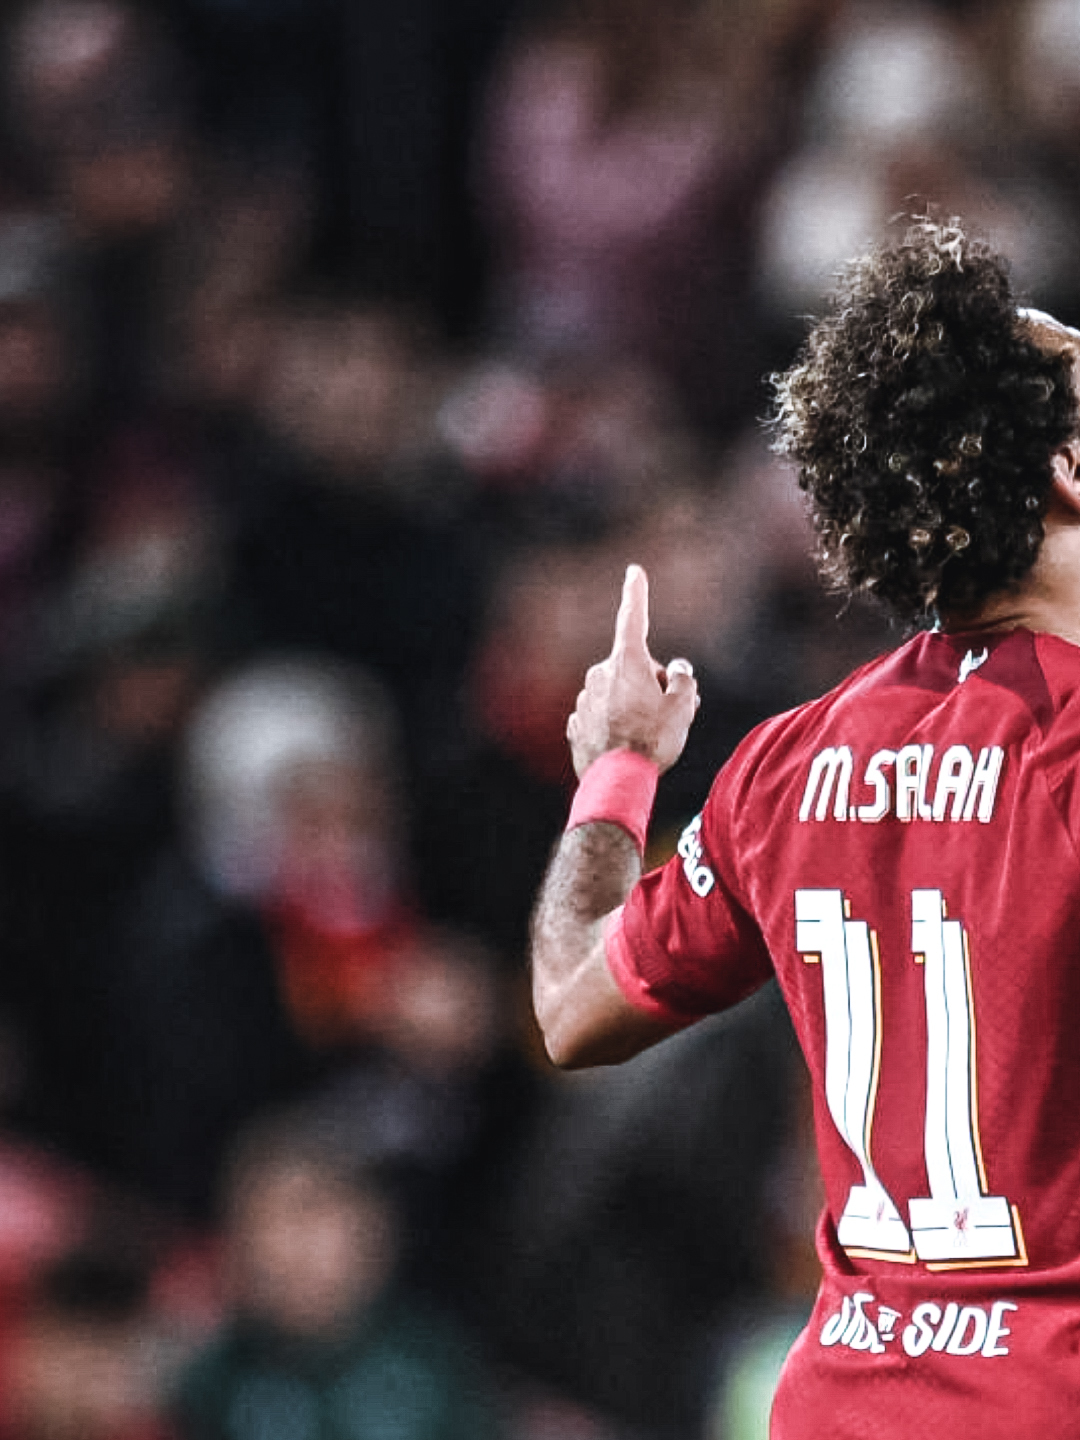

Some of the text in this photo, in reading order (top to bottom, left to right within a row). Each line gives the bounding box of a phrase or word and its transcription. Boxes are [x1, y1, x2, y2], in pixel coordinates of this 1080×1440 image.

[799, 743, 1004, 823] M.SALAH
[795, 888, 1028, 1271] 11
[902, 1301, 1018, 1358] SIDE
